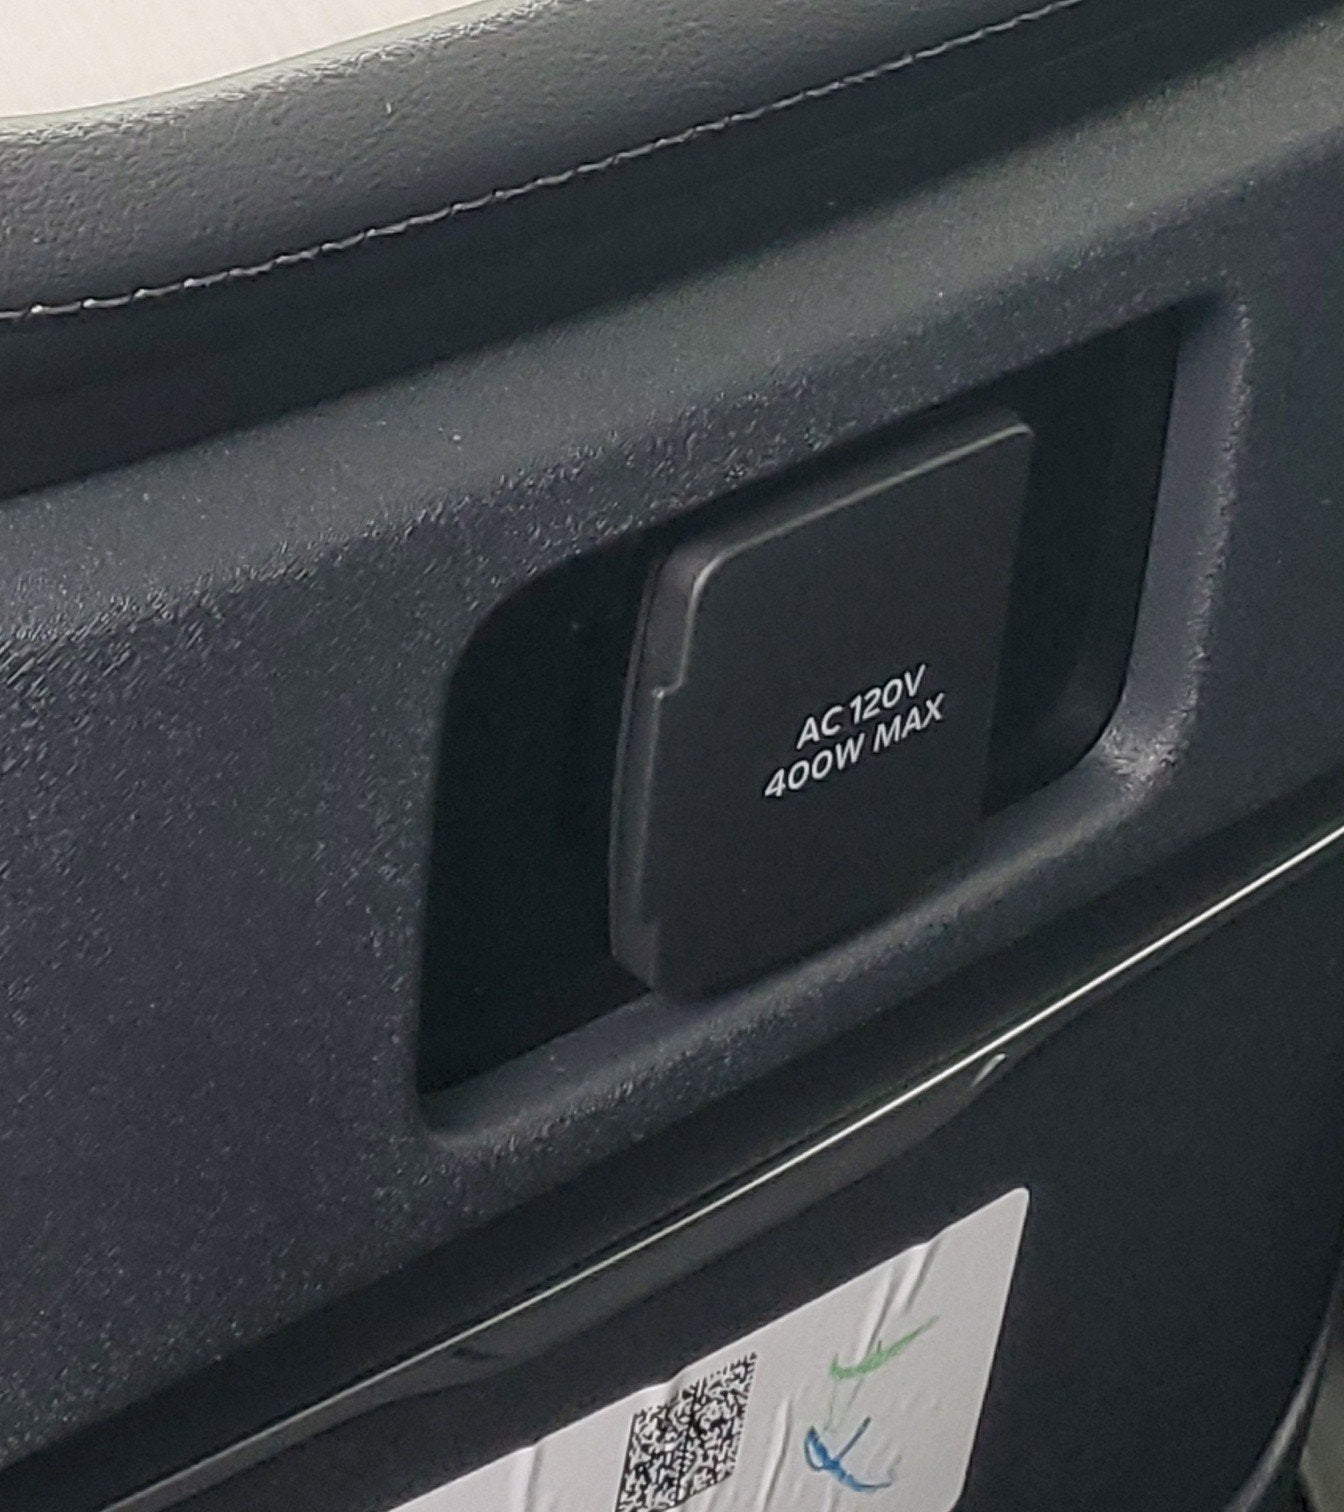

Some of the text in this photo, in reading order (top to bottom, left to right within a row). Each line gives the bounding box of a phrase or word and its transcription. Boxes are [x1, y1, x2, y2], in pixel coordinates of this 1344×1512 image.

[764, 692, 944, 797] 400W MAX
[796, 664, 926, 750] AC 120V
